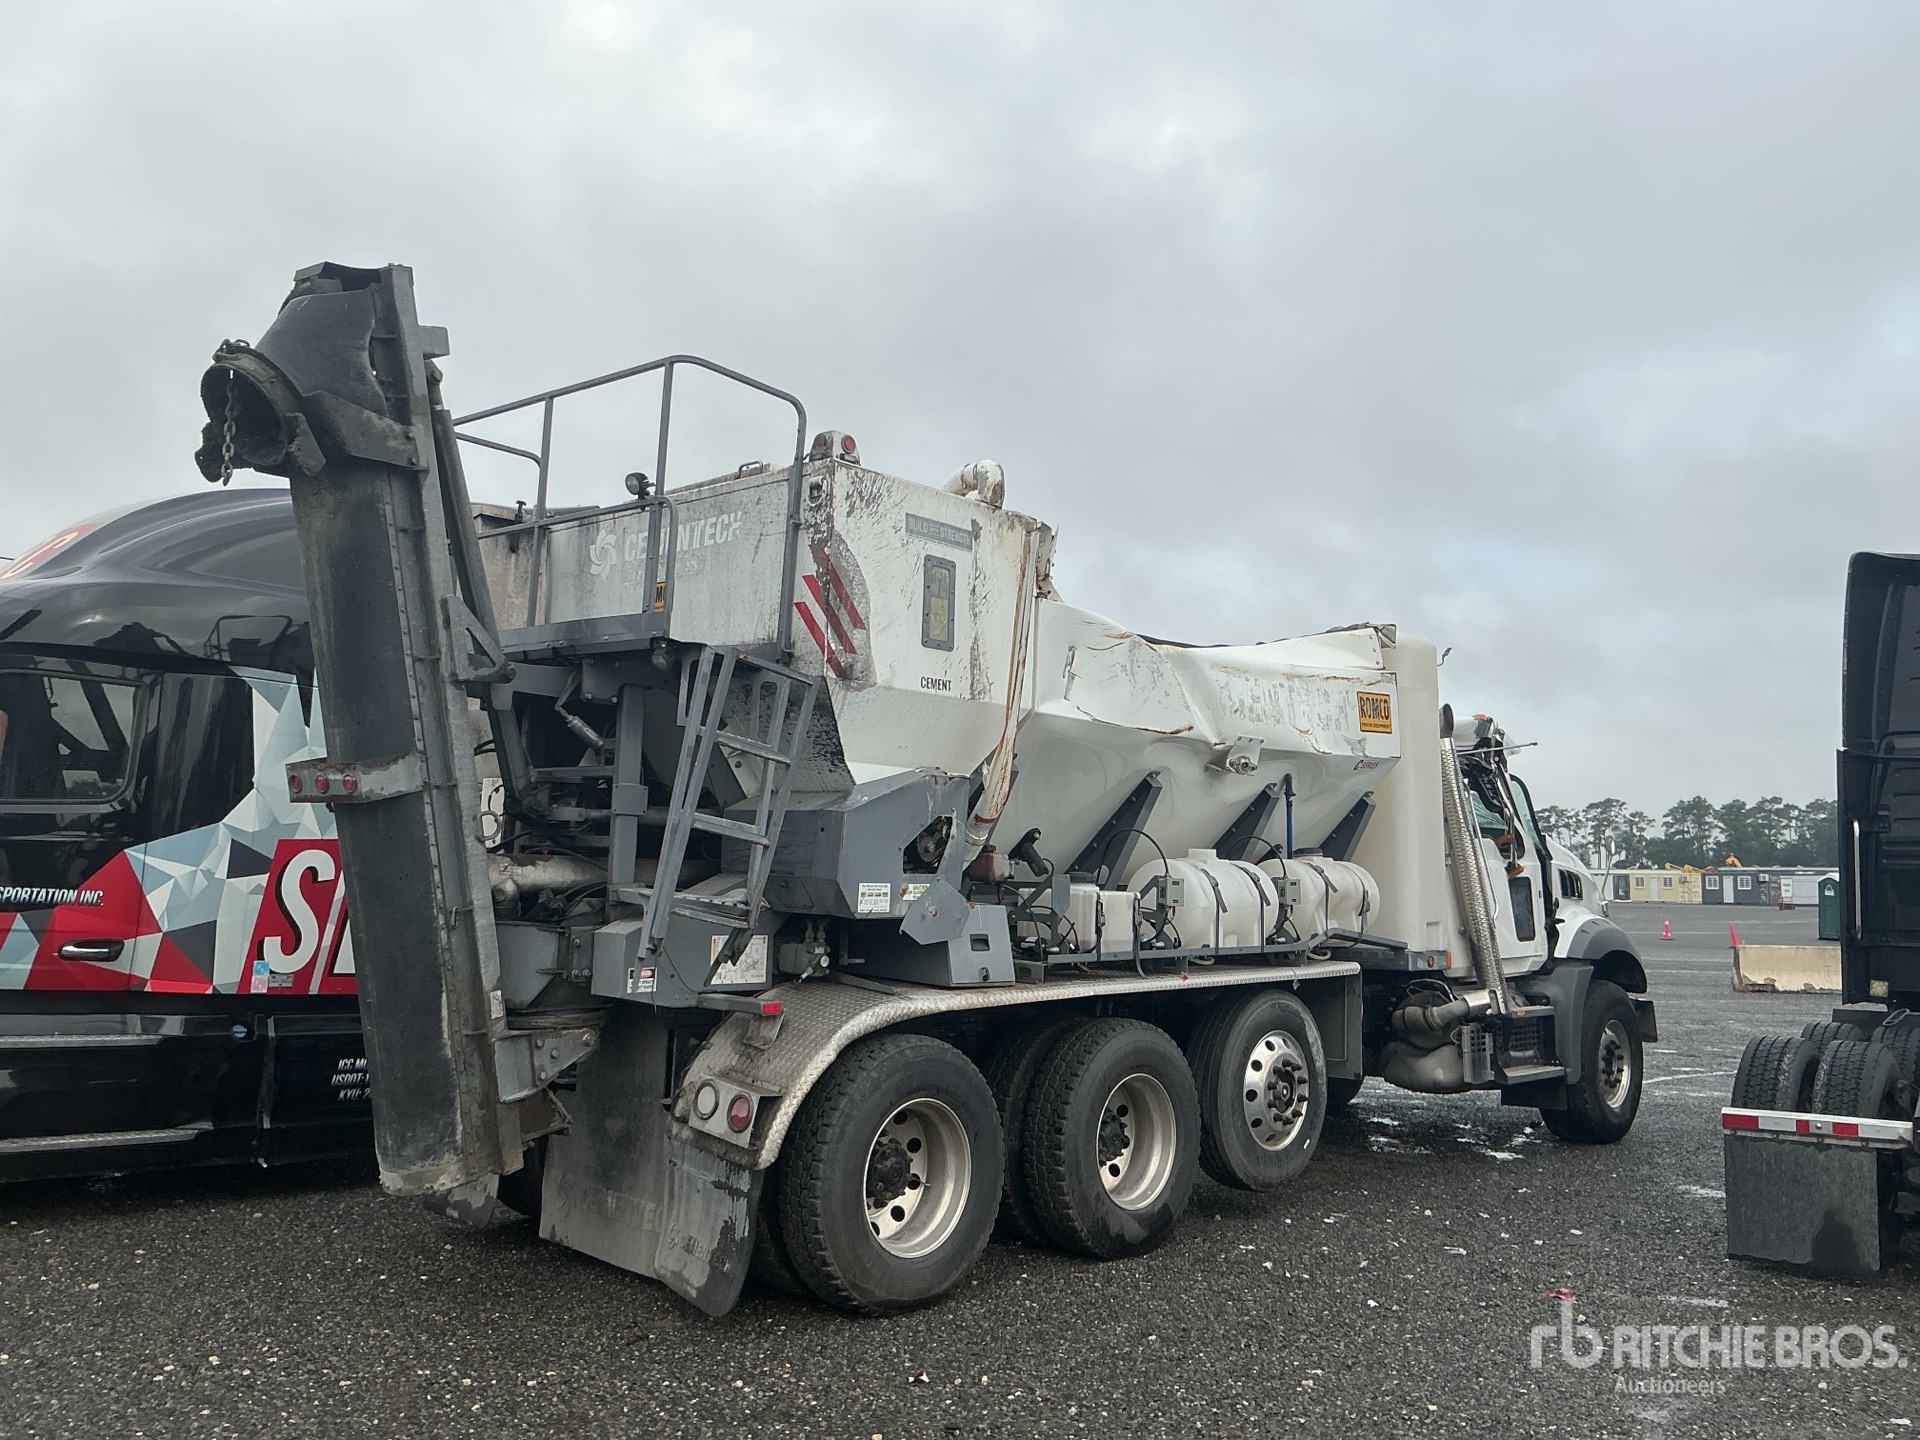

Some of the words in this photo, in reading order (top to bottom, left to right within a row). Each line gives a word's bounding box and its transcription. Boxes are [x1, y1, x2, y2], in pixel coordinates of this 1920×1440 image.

[921, 676, 951, 691] CEMENT
[1359, 696, 1390, 720] ROMCO
[80, 889, 104, 906] INC.
